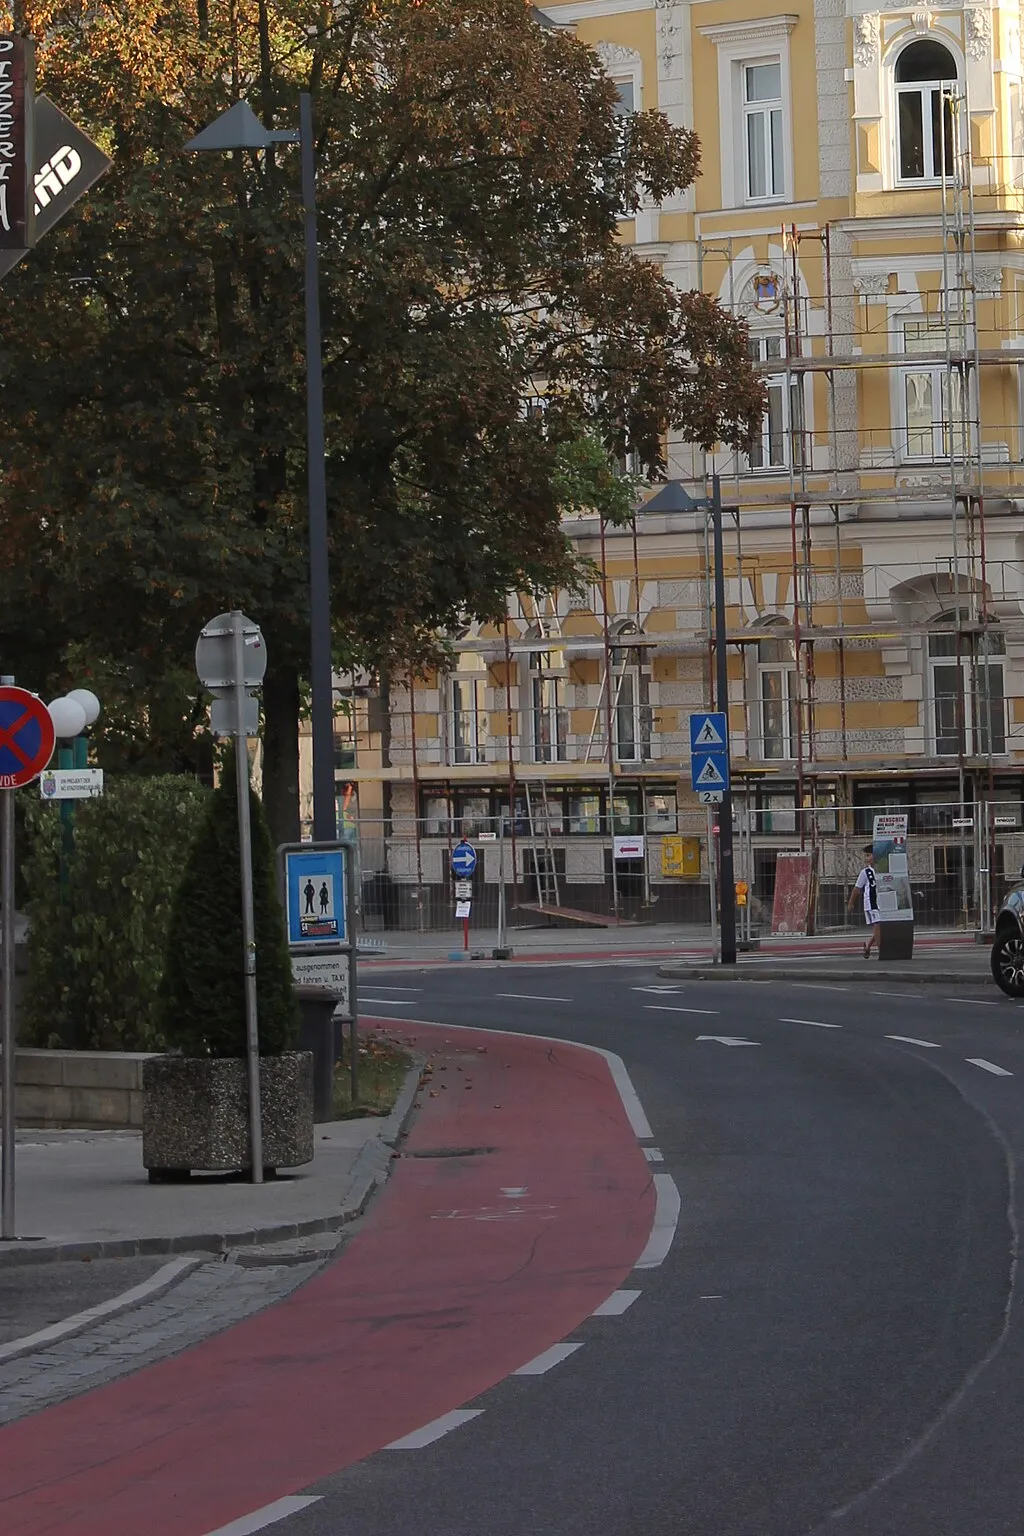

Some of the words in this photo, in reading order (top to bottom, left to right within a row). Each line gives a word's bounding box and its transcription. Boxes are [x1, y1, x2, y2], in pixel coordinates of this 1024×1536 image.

[34, 145, 82, 216] ND
[296, 963, 340, 972] ausgenommen
[332, 974, 345, 982] TAXI
